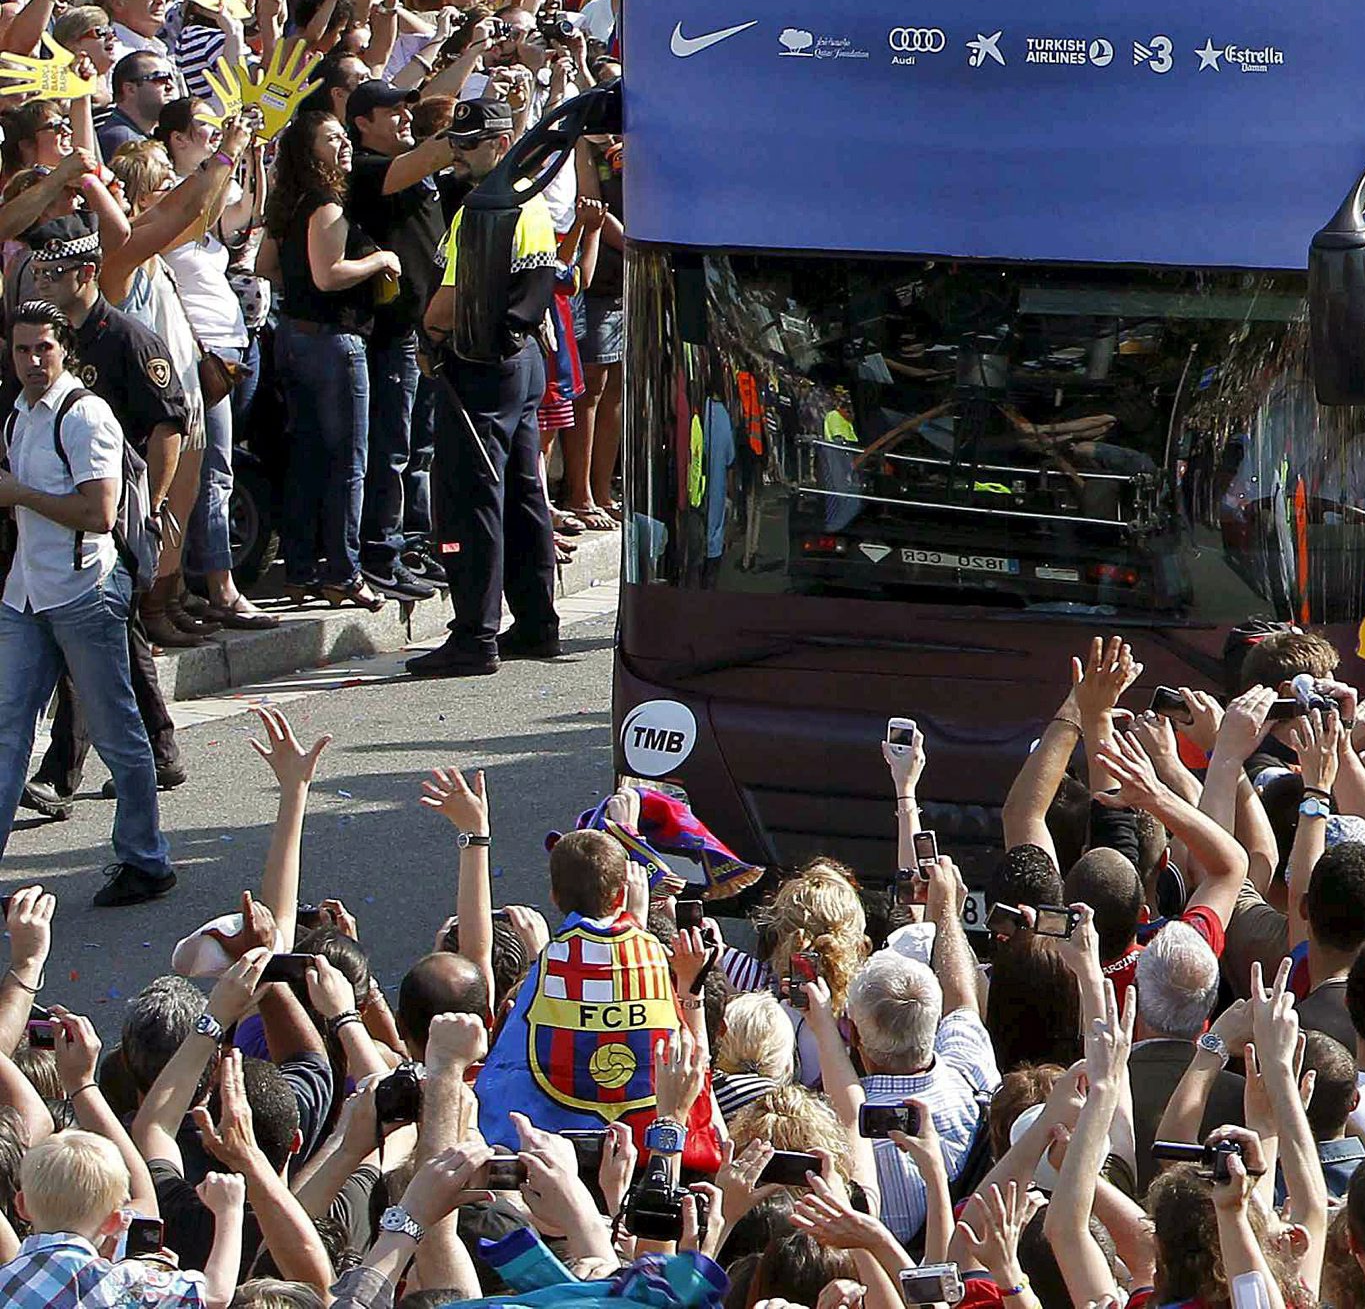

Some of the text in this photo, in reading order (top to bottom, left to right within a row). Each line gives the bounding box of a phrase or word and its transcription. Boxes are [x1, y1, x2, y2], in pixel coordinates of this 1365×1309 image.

[1026, 38, 1086, 51] TURKISH
[1149, 34, 1174, 74] 3
[1224, 44, 1284, 65] Estrella
[891, 56, 916, 65] Audi
[1025, 51, 1086, 65] AIRLINES
[632, 725, 685, 753] TMB
[579, 1002, 648, 1030] FCB
